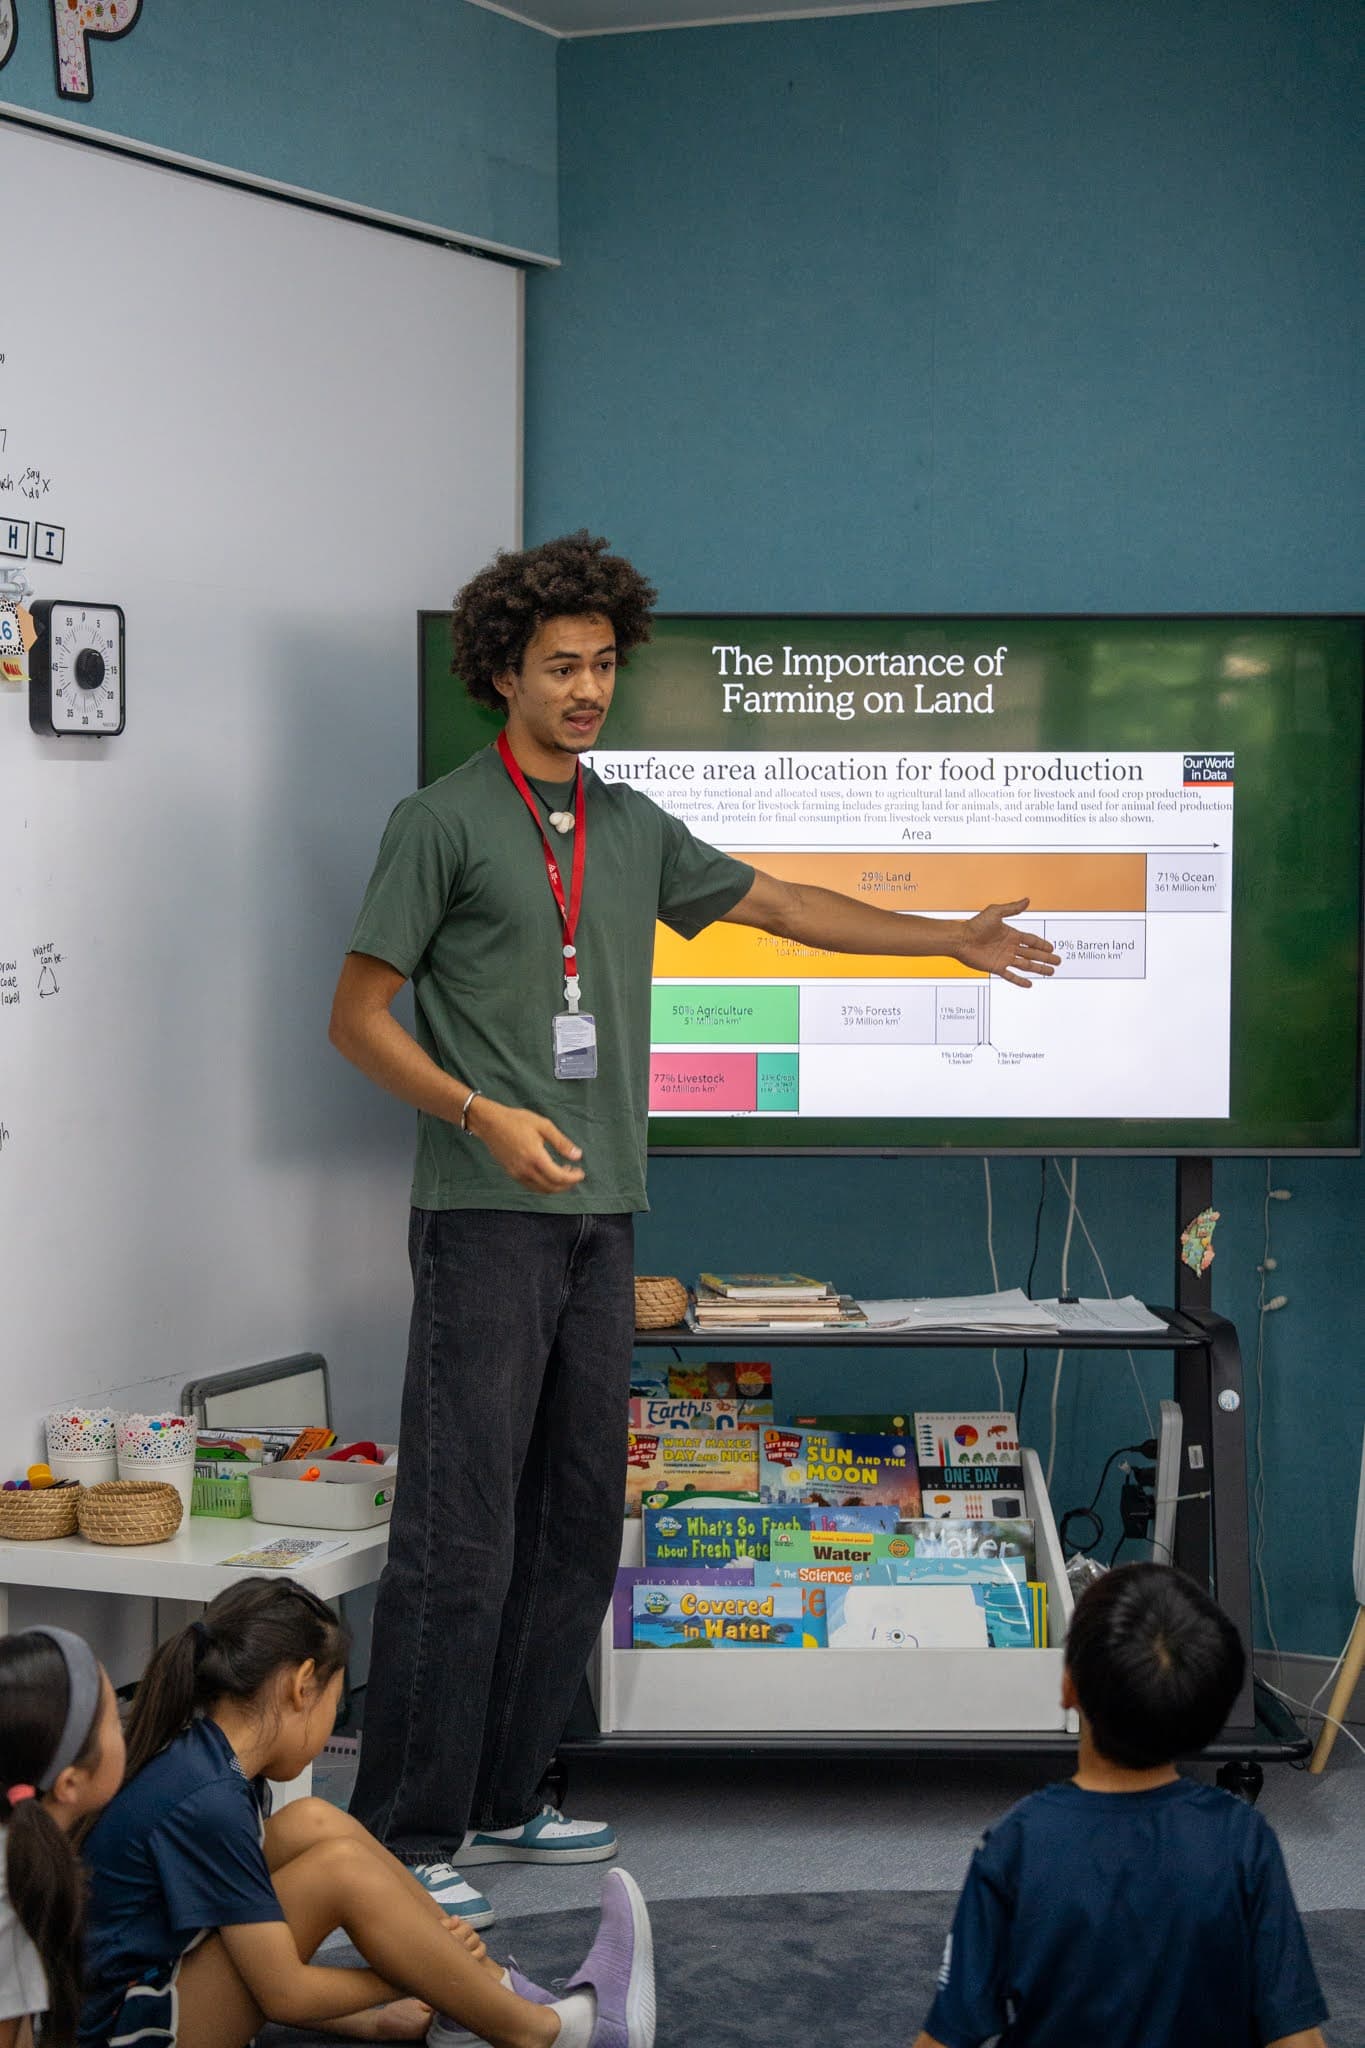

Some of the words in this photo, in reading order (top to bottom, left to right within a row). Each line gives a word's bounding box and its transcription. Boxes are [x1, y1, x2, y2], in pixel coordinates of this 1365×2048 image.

[8, 525, 19, 549] H
[45, 531, 55, 557] I
[111, 666, 117, 675] 15
[712, 646, 773, 676] The
[782, 646, 964, 683] Importance
[973, 646, 1007, 676] of
[722, 683, 855, 720] Farming
[863, 692, 904, 713] on
[914, 684, 994, 713] Land
[1184, 757, 1205, 769] Our
[1205, 757, 1235, 769] World
[603, 757, 695, 780] surface
[703, 763, 756, 780] area
[764, 757, 888, 780] allocation
[896, 758, 932, 780] for
[940, 758, 994, 780] food
[1004, 759, 1144, 786] production
[1191, 770, 1201, 780] in
[1203, 769, 1227, 780] Data
[690, 788, 702, 799] by
[704, 788, 752, 797] functional
[755, 788, 772, 797] and
[775, 788, 817, 797] allocated
[820, 791, 844, 799] uses,
[846, 789, 872, 798] down
[875, 789, 884, 798] to
[887, 789, 942, 800] agricultural
[945, 789, 965, 798] land
[968, 789, 1015, 798] allocation
[1017, 789, 1031, 798] for
[1034, 789, 1075, 798] livestock
[1077, 789, 1095, 798] and
[1098, 789, 1119, 798] food
[1122, 792, 1144, 800] crop
[1146, 789, 1202, 800] production,
[717, 800, 739, 809] Area
[742, 800, 755, 809] for
[758, 800, 799, 809] livestock
[802, 801, 840, 812] farming
[843, 801, 881, 810] includes
[884, 801, 919, 812] grazing
[922, 801, 943, 810] land
[945, 801, 959, 810] for
[962, 801, 1000, 812] animals,
[1004, 801, 1021, 810] and
[1025, 801, 1054, 810] arable
[1057, 802, 1077, 811] land
[1080, 802, 1102, 811] used
[1105, 802, 1118, 811] for
[1121, 802, 1154, 811] animal
[1157, 802, 1176, 811] feed
[1179, 802, 1233, 813] production
[701, 813, 719, 822] and
[722, 813, 757, 824] protein
[759, 813, 772, 822] for
[775, 813, 796, 822] final
[799, 813, 861, 824] consumption
[864, 813, 887, 822] from
[889, 813, 930, 822] livestock
[966, 814, 1022, 825] plant-based
[1025, 814, 1086, 823] commodities
[1089, 814, 1097, 823] is
[1099, 814, 1117, 823] also
[1120, 814, 1154, 823] shown.
[902, 828, 931, 840] Area
[862, 872, 883, 881] 29%
[886, 872, 911, 881] Land
[1157, 872, 1179, 882] 71%
[1182, 872, 1214, 882] Ocean
[874, 883, 901, 892] Million
[1155, 883, 1169, 892] 361
[1172, 883, 1199, 892] Million
[1053, 940, 1074, 950] 19%
[1077, 940, 1110, 950] Barren
[1112, 940, 1135, 950] land
[1066, 951, 1075, 960] 28
[1078, 951, 1105, 960] Million
[672, 1005, 695, 1015] 50%
[696, 1005, 753, 1017] Agriculture
[841, 1006, 863, 1016] 37%
[865, 1006, 901, 1016] Forests
[844, 1017, 854, 1026] 39
[855, 1017, 883, 1026] Million
[654, 1074, 675, 1083] 77%
[677, 1074, 725, 1083] Livestock
[647, 1401, 701, 1425] Earth
[663, 1438, 700, 1448] WHAT
[705, 1439, 752, 1449] MAKES
[806, 1436, 828, 1446] THE
[663, 1450, 697, 1461] DAY
[806, 1446, 853, 1465] SUN
[856, 1456, 882, 1466] AND
[884, 1458, 906, 1467] THE
[806, 1464, 879, 1485] MOON
[944, 1468, 972, 1483] ONE
[975, 1468, 999, 1483] DAY
[686, 1516, 733, 1537] What's
[736, 1516, 755, 1537] So
[657, 1545, 688, 1559] About
[691, 1539, 731, 1559] Fresh
[813, 1545, 872, 1562] Water
[783, 1570, 796, 1580] The
[799, 1568, 852, 1583] Science
[854, 1572, 863, 1581] of
[680, 1593, 775, 1616] Covered
[683, 1625, 700, 1639] in
[704, 1618, 772, 1641] Water
